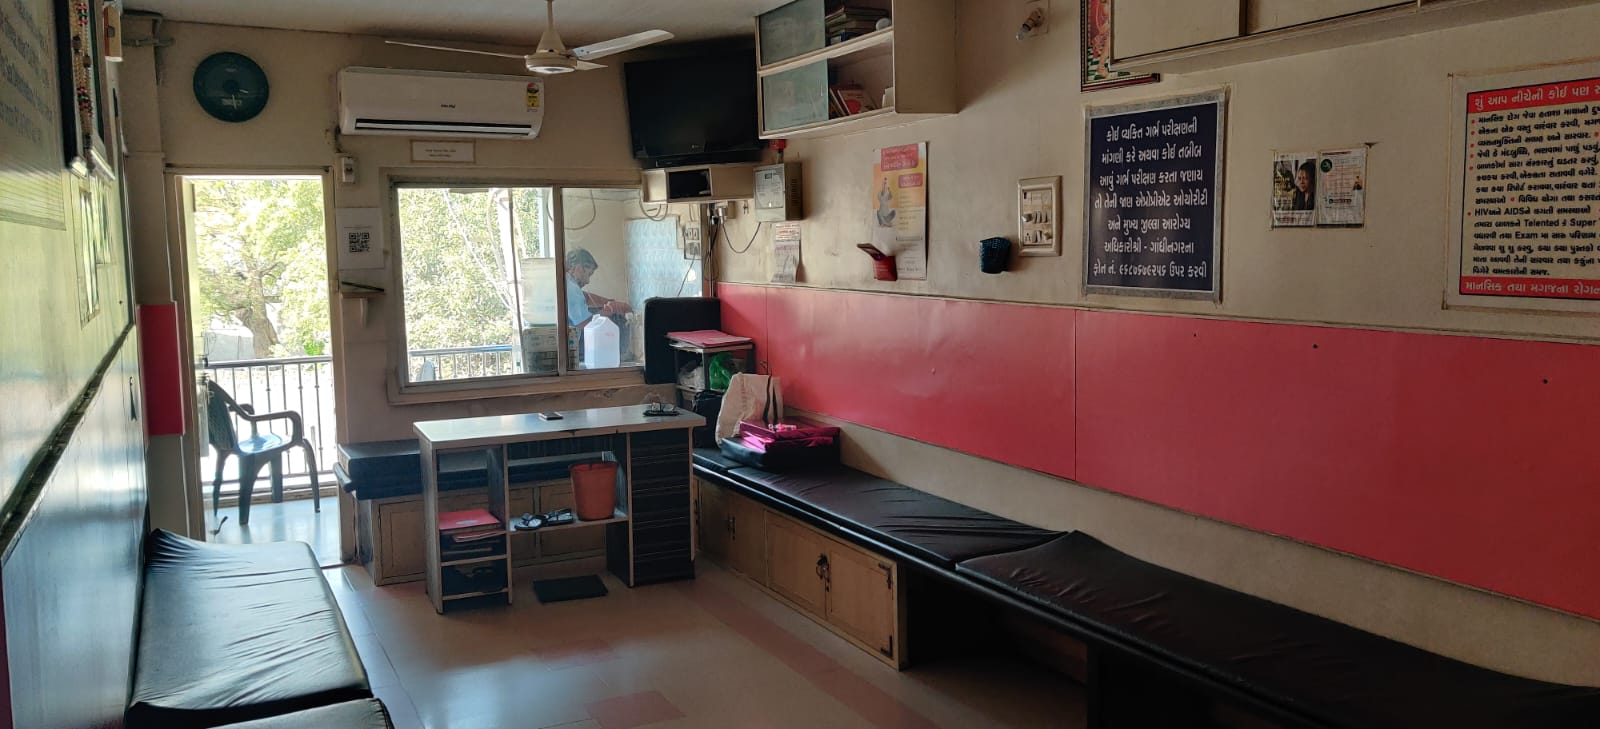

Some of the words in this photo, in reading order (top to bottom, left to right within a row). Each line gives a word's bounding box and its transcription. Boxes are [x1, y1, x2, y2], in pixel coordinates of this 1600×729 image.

[1488, 96, 1508, 105] આપ
[1512, 89, 1543, 102] નીચેની
[1549, 86, 1567, 99] કોઈ
[1572, 86, 1589, 97] પણ
[1106, 125, 1119, 142] કોઈ
[1145, 120, 1160, 138] ગર્ભ
[1161, 116, 1198, 136] પરીક્ષણની
[1102, 147, 1124, 164] માંગણી
[1125, 145, 1136, 163] કરે
[1138, 148, 1159, 162] અથવા
[1161, 143, 1176, 160] કોઈ
[1178, 141, 1202, 158] તબીબ
[1099, 171, 1114, 191] આવું
[1116, 169, 1129, 186] ગર્ભ
[1131, 168, 1156, 185] પરીક્ષણ
[1158, 171, 1177, 183] કરતા
[1180, 169, 1203, 182] જણાય
[1093, 193, 1102, 209] તો
[1104, 192, 1117, 209] તેની
[1119, 194, 1133, 208] જાણ
[1135, 190, 1171, 207] એપ્રોપ્રીએટ
[1173, 188, 1208, 206] ઓથોરીટી
[1108, 214, 1121, 231] અને
[1123, 218, 1138, 236] મુખ્ય
[1162, 213, 1191, 230] આરોગ્ય
[1524, 219, 1559, 227] Telented
[1570, 218, 1597, 228] Super
[1515, 231, 1538, 239] Exam
[1104, 237, 1142, 253] અધિકારીશ્રી
[1150, 237, 1194, 254] ગાંધીનગરના
[1093, 258, 1106, 277] ફોન
[1169, 261, 1185, 277] ઉપર
[1187, 261, 1207, 278] કરવી
[1465, 279, 1502, 291] માનસિક
[1507, 283, 1526, 291] તથા
[1530, 283, 1569, 293] મગજના
